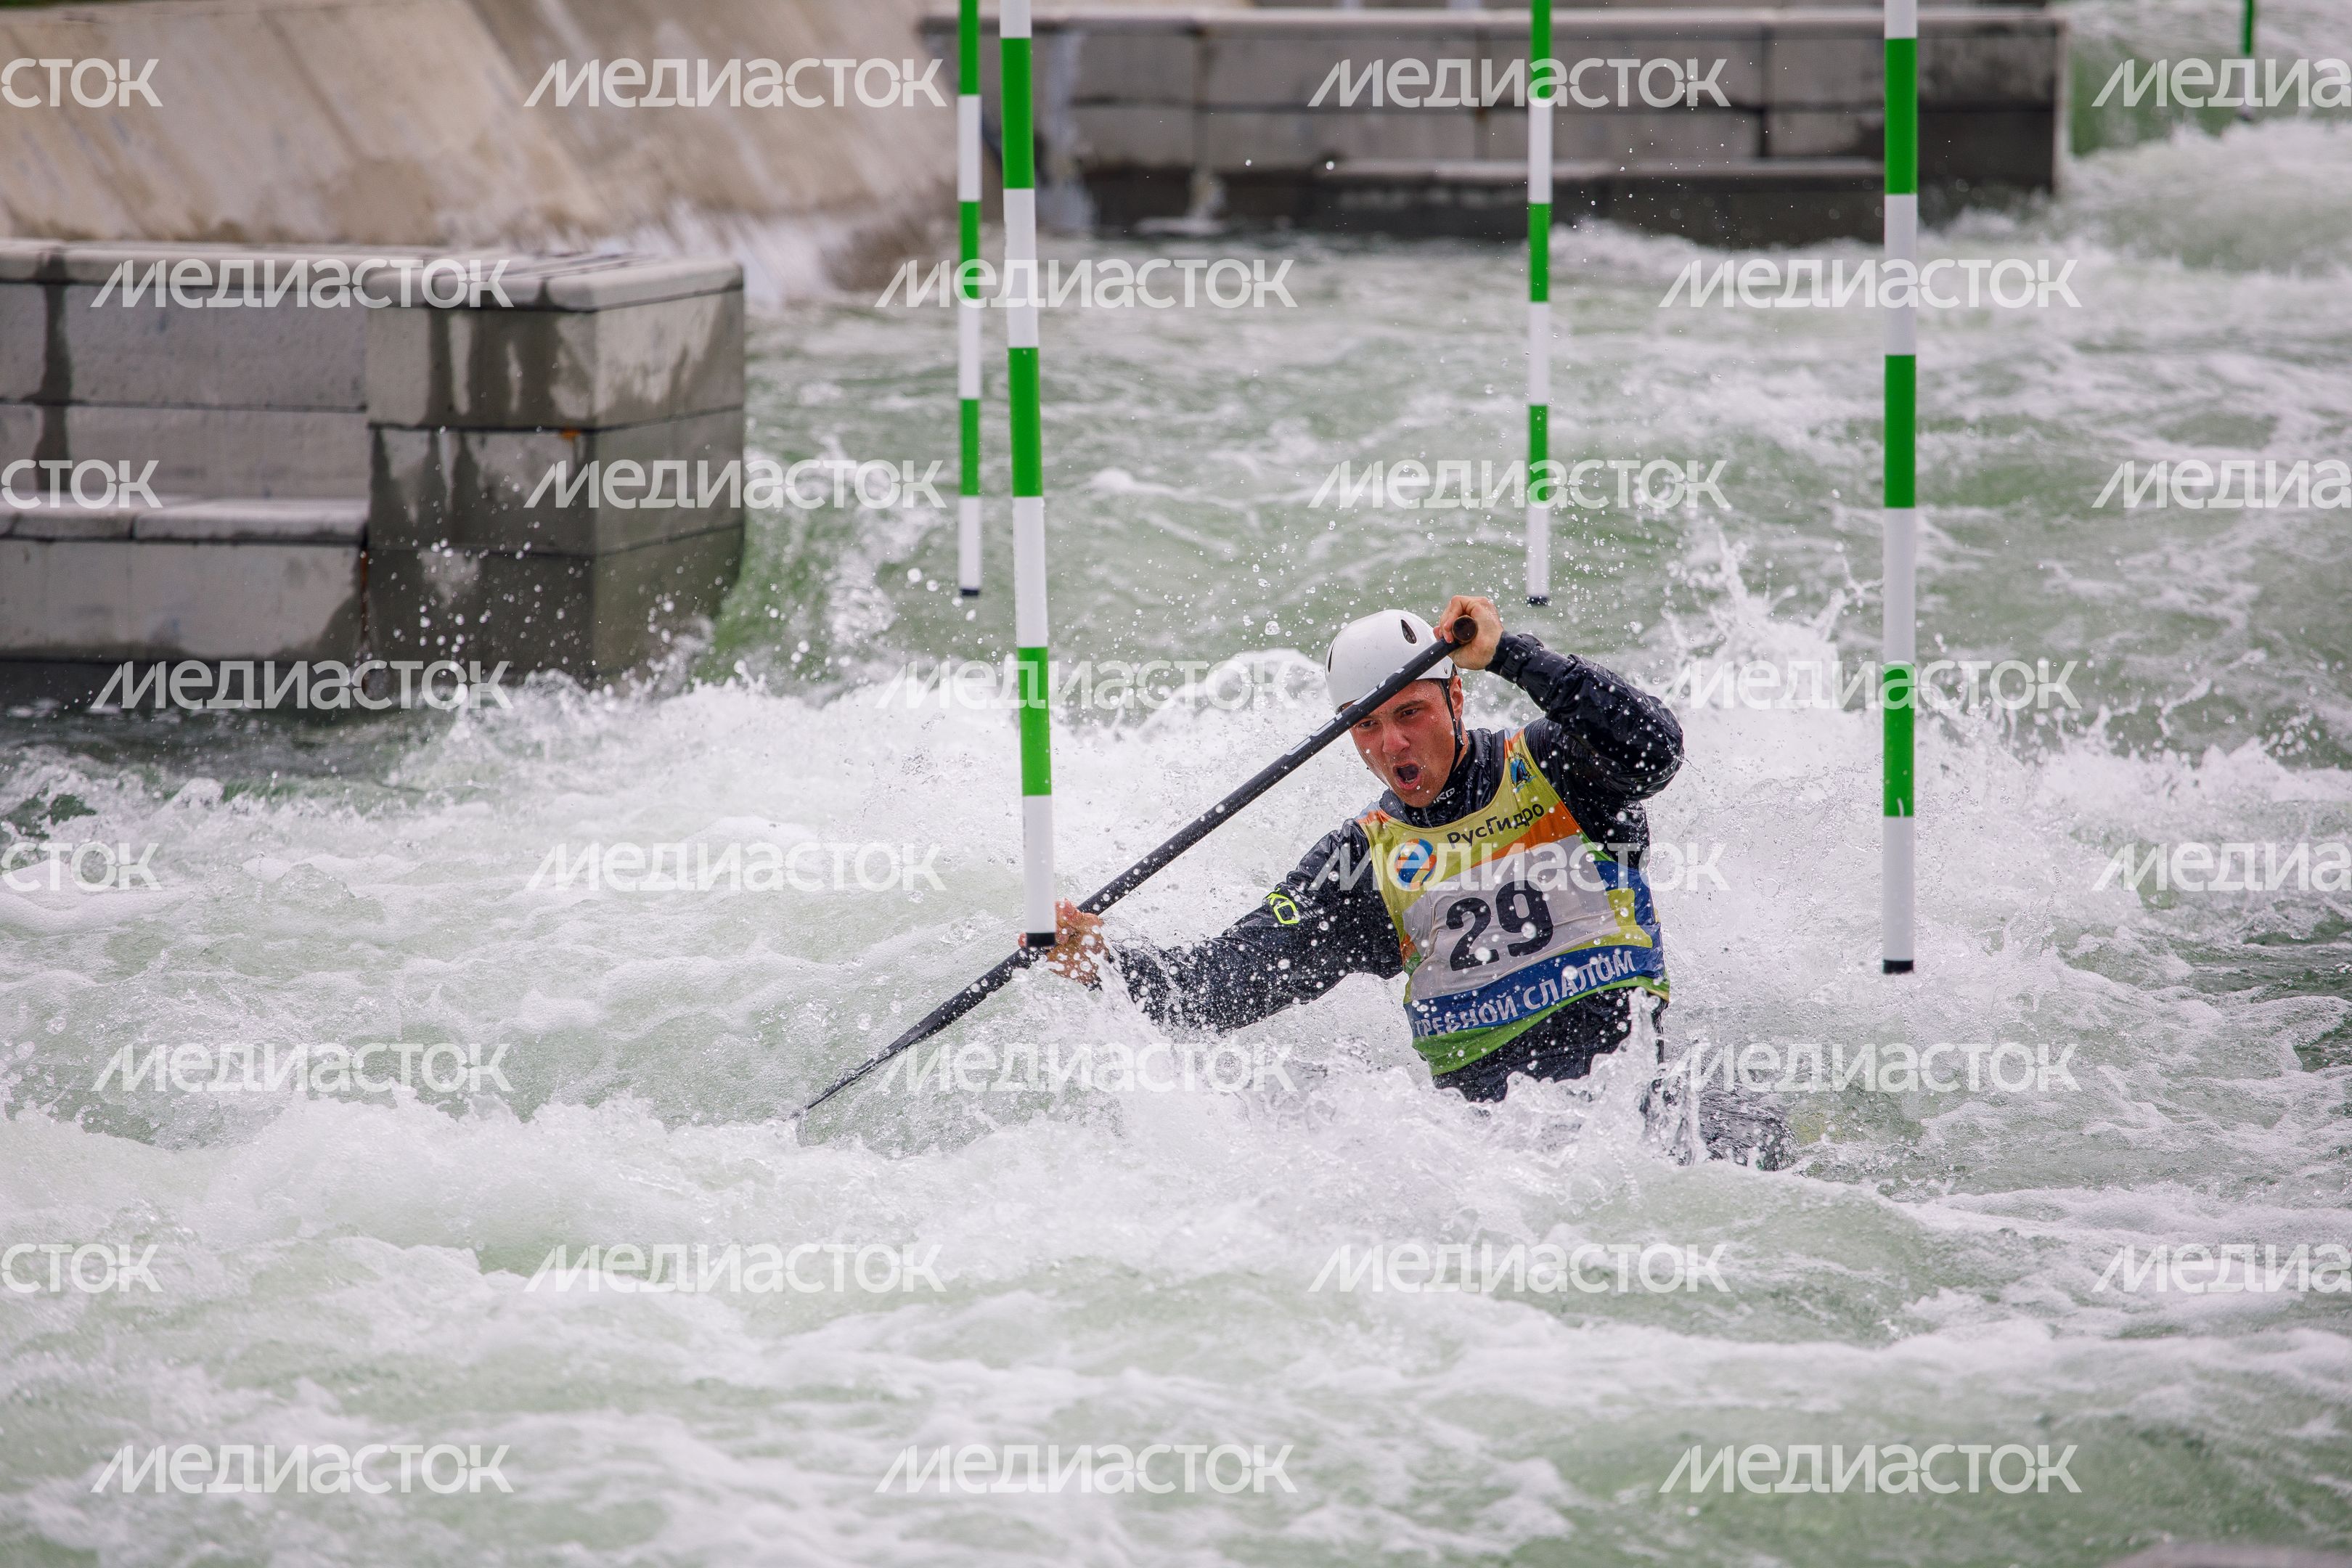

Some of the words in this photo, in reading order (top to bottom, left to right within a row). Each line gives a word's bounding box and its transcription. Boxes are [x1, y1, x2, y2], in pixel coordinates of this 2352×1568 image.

[1447, 804, 1544, 849] РусГидро
[1445, 881, 1553, 971] 29
[1524, 950, 1636, 1010] СЛАЛОМ
